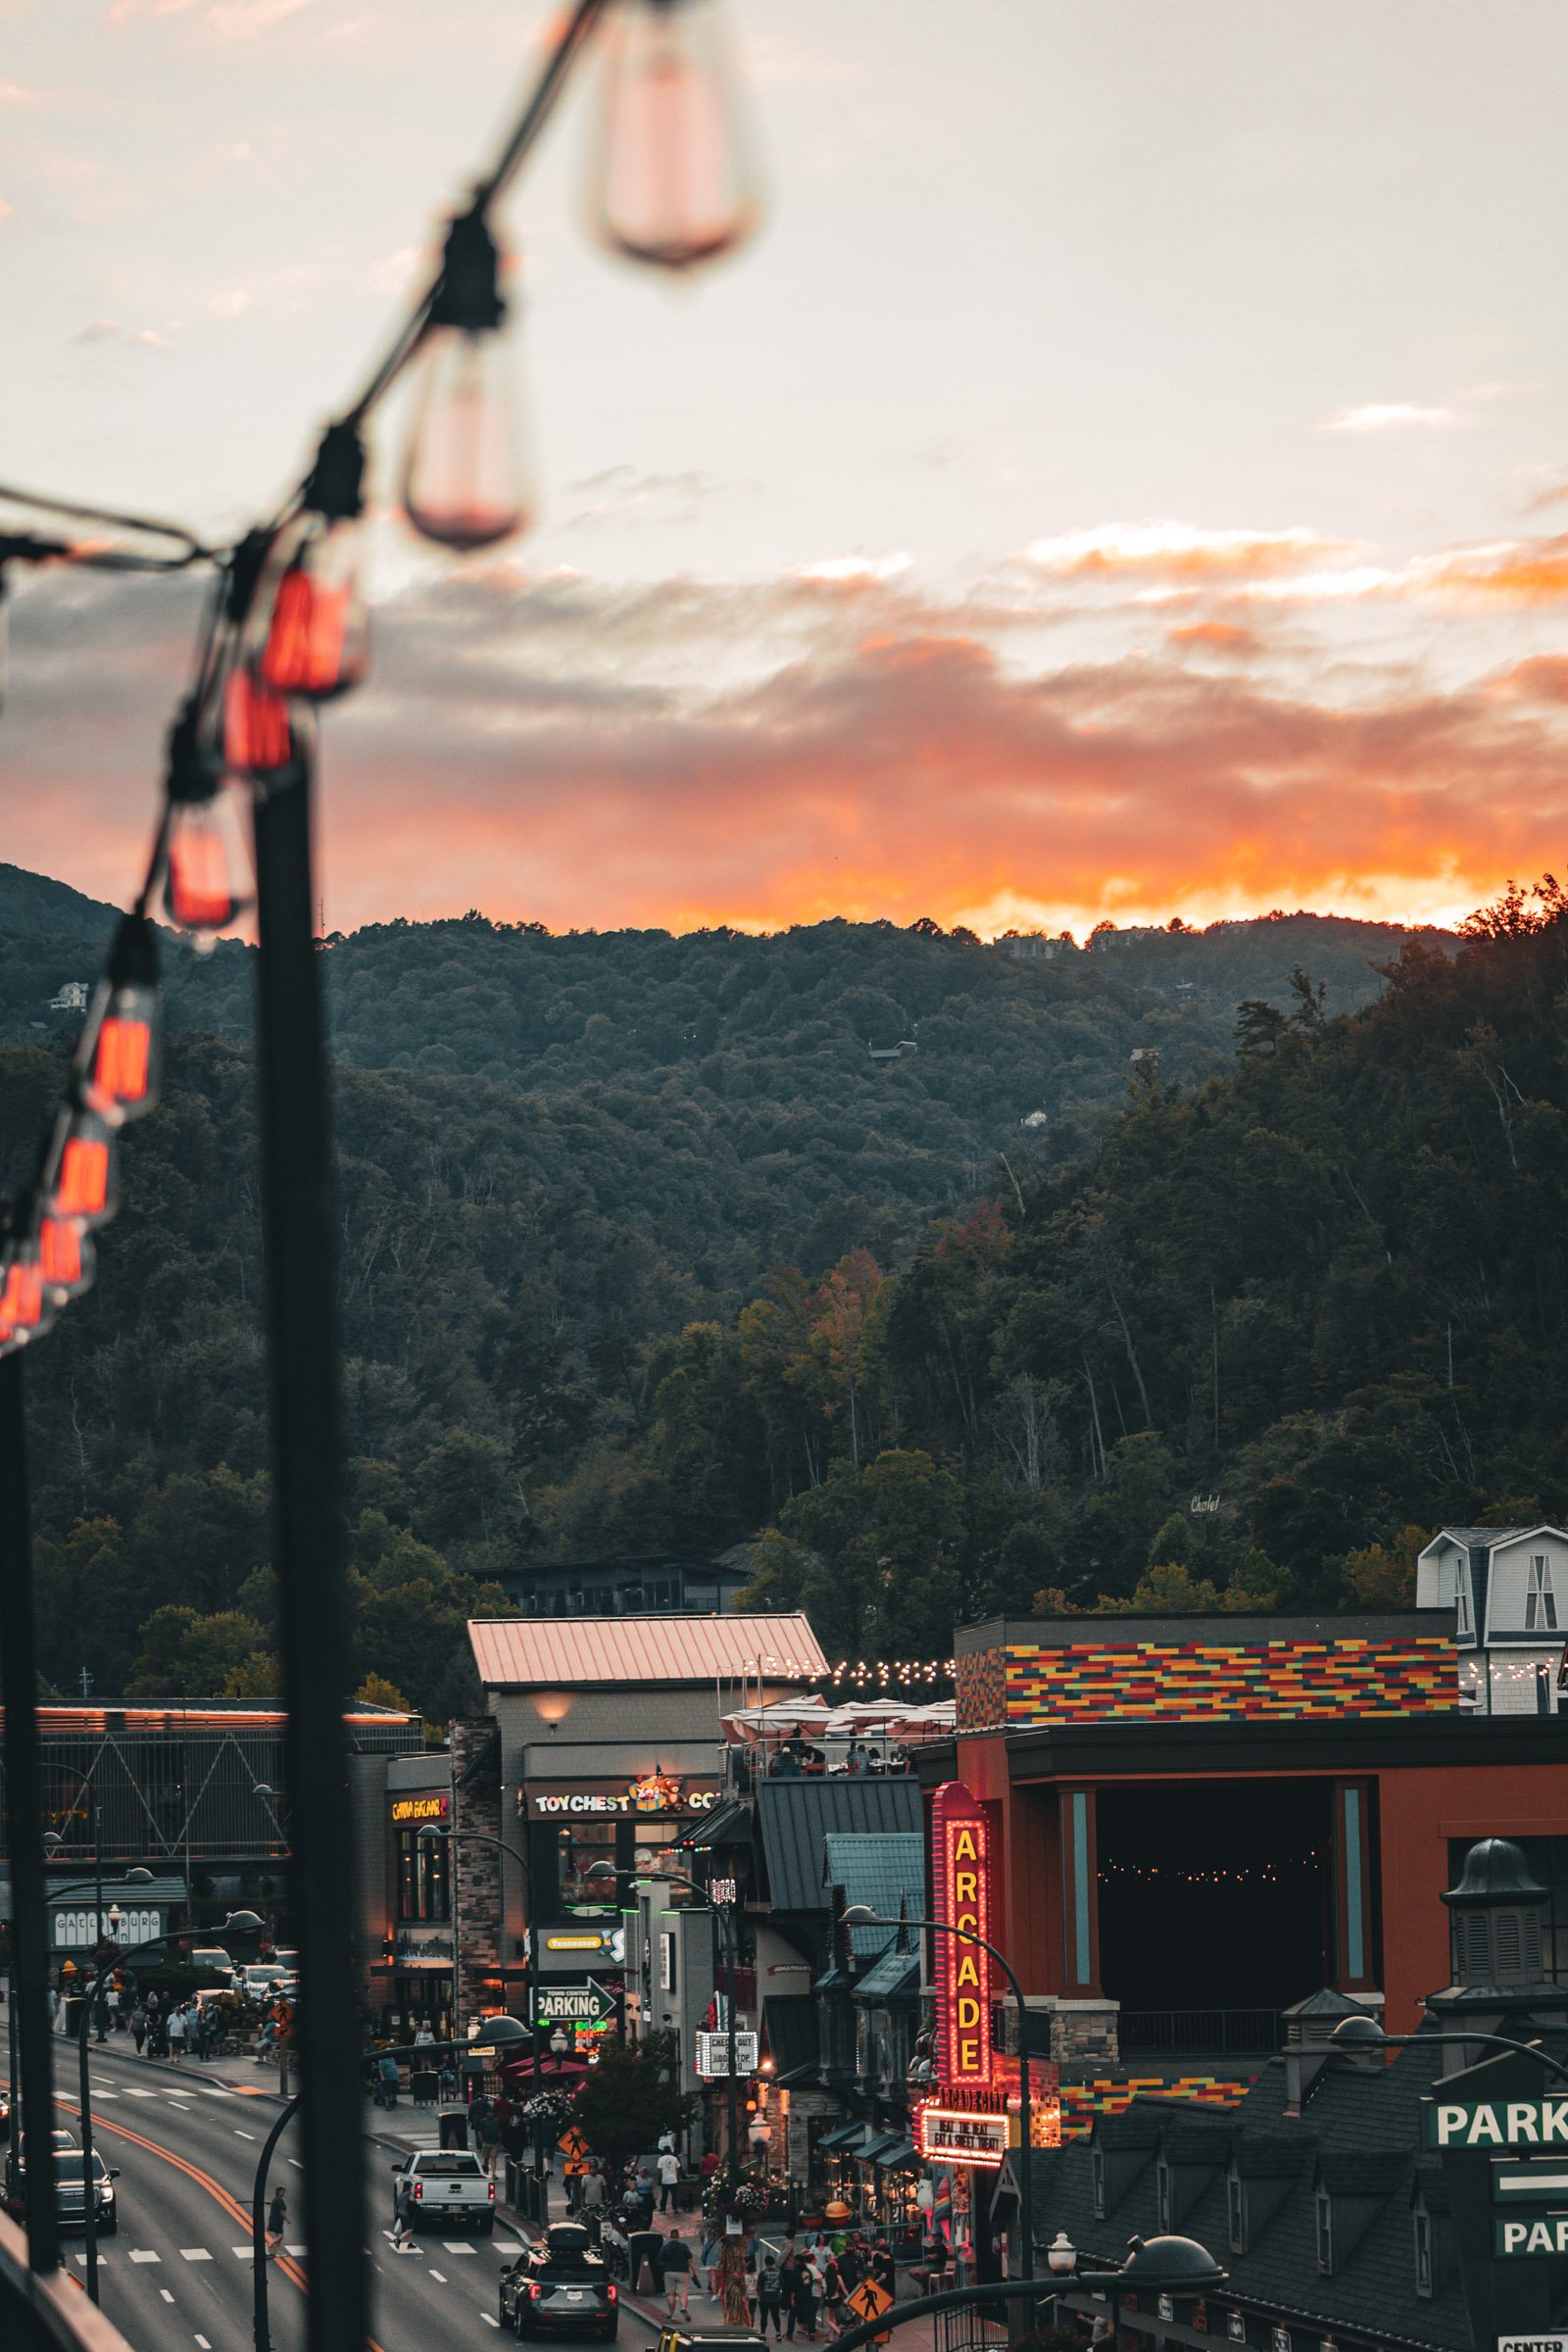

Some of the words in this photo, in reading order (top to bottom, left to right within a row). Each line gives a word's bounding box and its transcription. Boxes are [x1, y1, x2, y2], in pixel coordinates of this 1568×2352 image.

[1191, 1494, 1220, 1512] Chalet
[570, 1794, 630, 1812] CHEST
[57, 1916, 159, 1929] GATLBURG
[955, 1830, 979, 2071] ARCADE
[538, 1996, 600, 2016] PARKING
[938, 2087, 978, 2112] ARCADE
[979, 2090, 1004, 2114] CITY
[934, 2132, 946, 2146] EAT
[948, 2133, 953, 2146] A
[955, 2134, 974, 2149] SWEET
